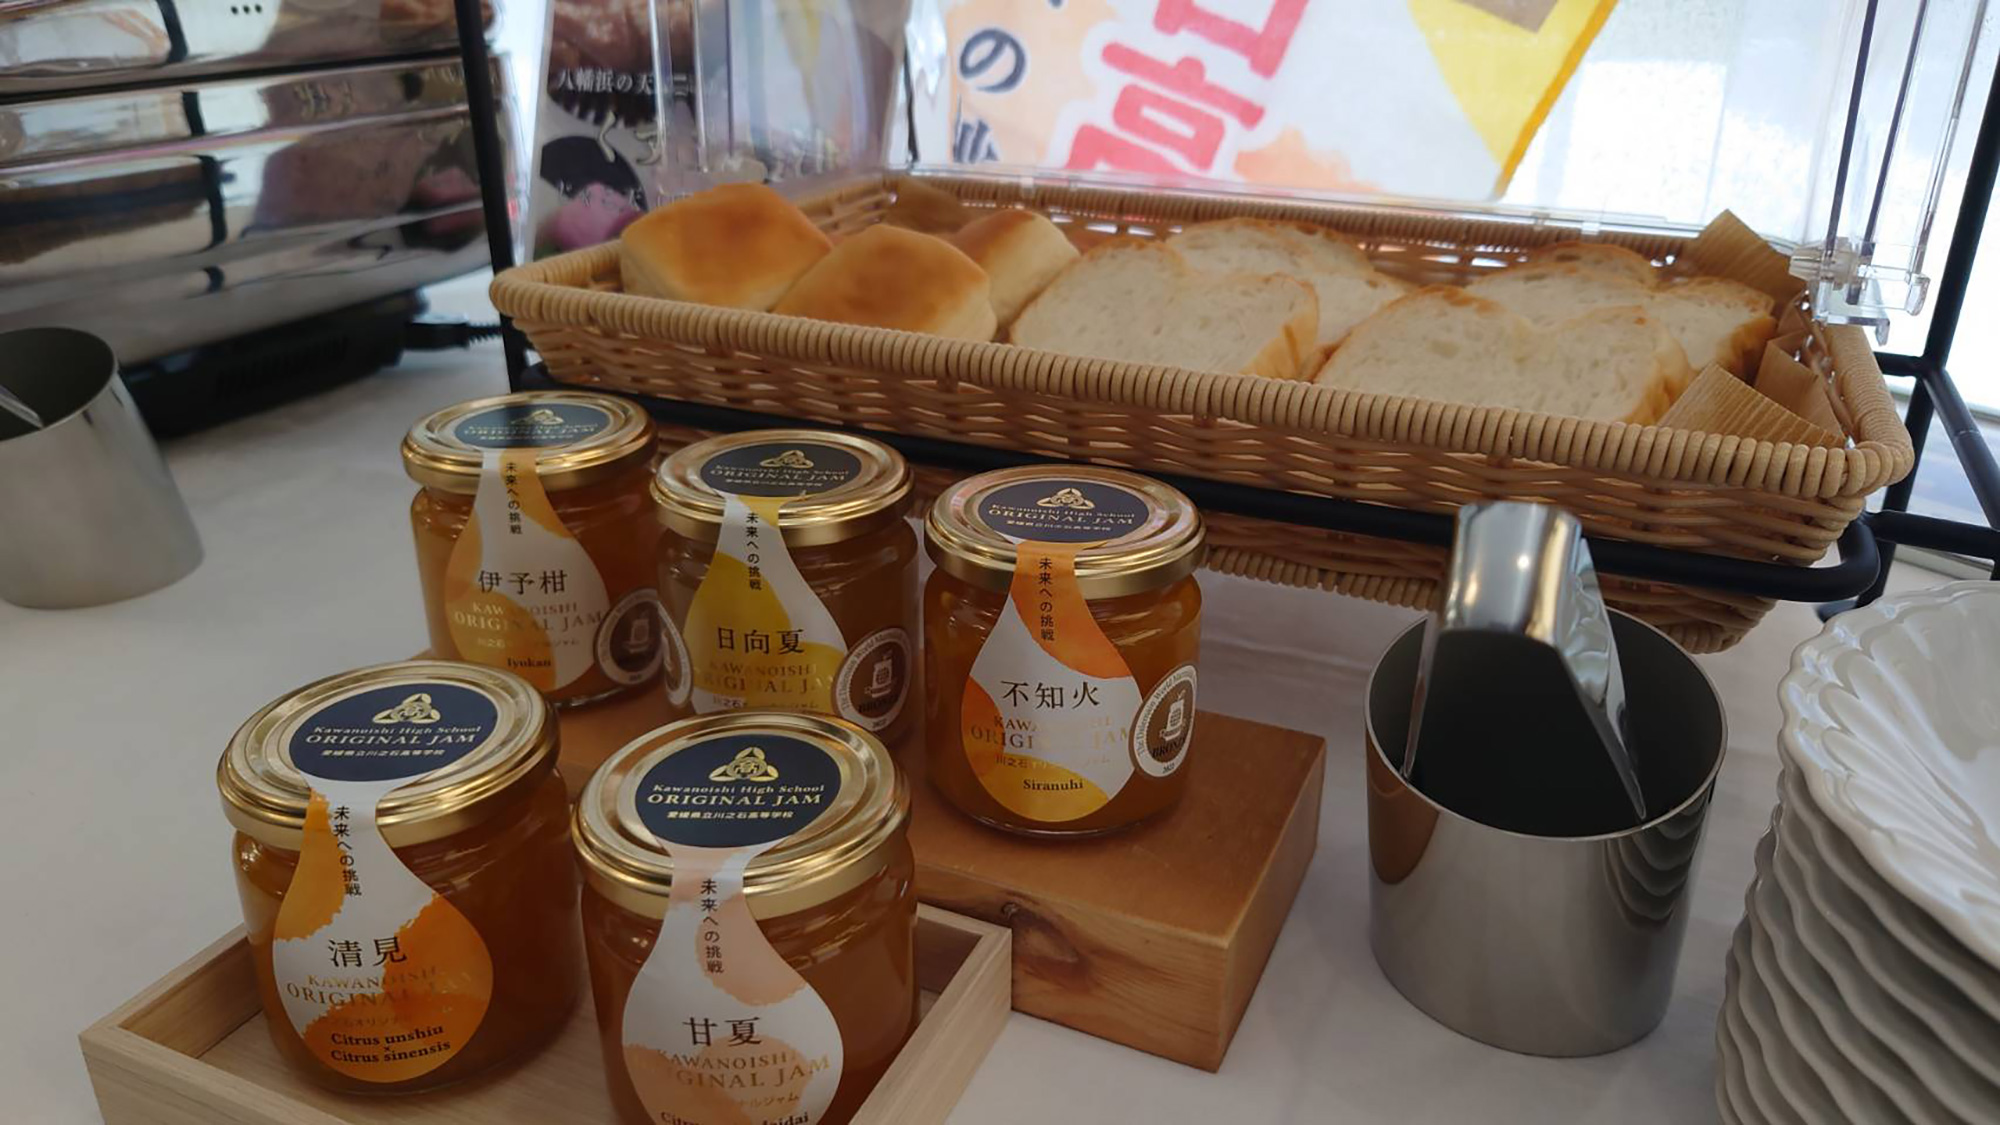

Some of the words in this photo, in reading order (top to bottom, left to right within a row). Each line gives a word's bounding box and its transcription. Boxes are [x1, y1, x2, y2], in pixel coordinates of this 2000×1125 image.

[710, 469, 803, 481] ORIGINAL
[809, 473, 846, 481] JAM
[505, 462, 522, 535] 未来への挑戦
[988, 508, 1087, 524] ORIGINAL
[1091, 517, 1133, 525] JAM
[746, 512, 762, 591] 未来への挑戦
[478, 569, 567, 595] 伊予柑
[473, 602, 577, 617] KAWOISHI
[1039, 557, 1055, 642] 未来への挑戦
[717, 626, 806, 655] 日向夏
[1000, 680, 1100, 710] 不知火
[305, 734, 422, 745] ORIGINAL
[425, 734, 477, 746] JAM
[399, 725, 433, 737] High
[435, 724, 483, 734] School
[652, 783, 735, 794] Kawanoishi
[740, 785, 774, 795] High
[778, 783, 826, 793] School
[1022, 778, 1084, 791] Siranuhi
[646, 793, 766, 806] ORIGINAL
[771, 793, 824, 808] JAM
[333, 805, 362, 897] 未来への挑戦
[700, 878, 725, 975] 未来への挑戦
[327, 936, 408, 968] 清見
[330, 1032, 381, 1046] Citrus
[384, 1025, 444, 1046] unshiu
[682, 1016, 763, 1047] 甘夏
[330, 1050, 380, 1063] Citrus
[383, 1040, 452, 1063] sinensis
[774, 1054, 830, 1088] JAM
